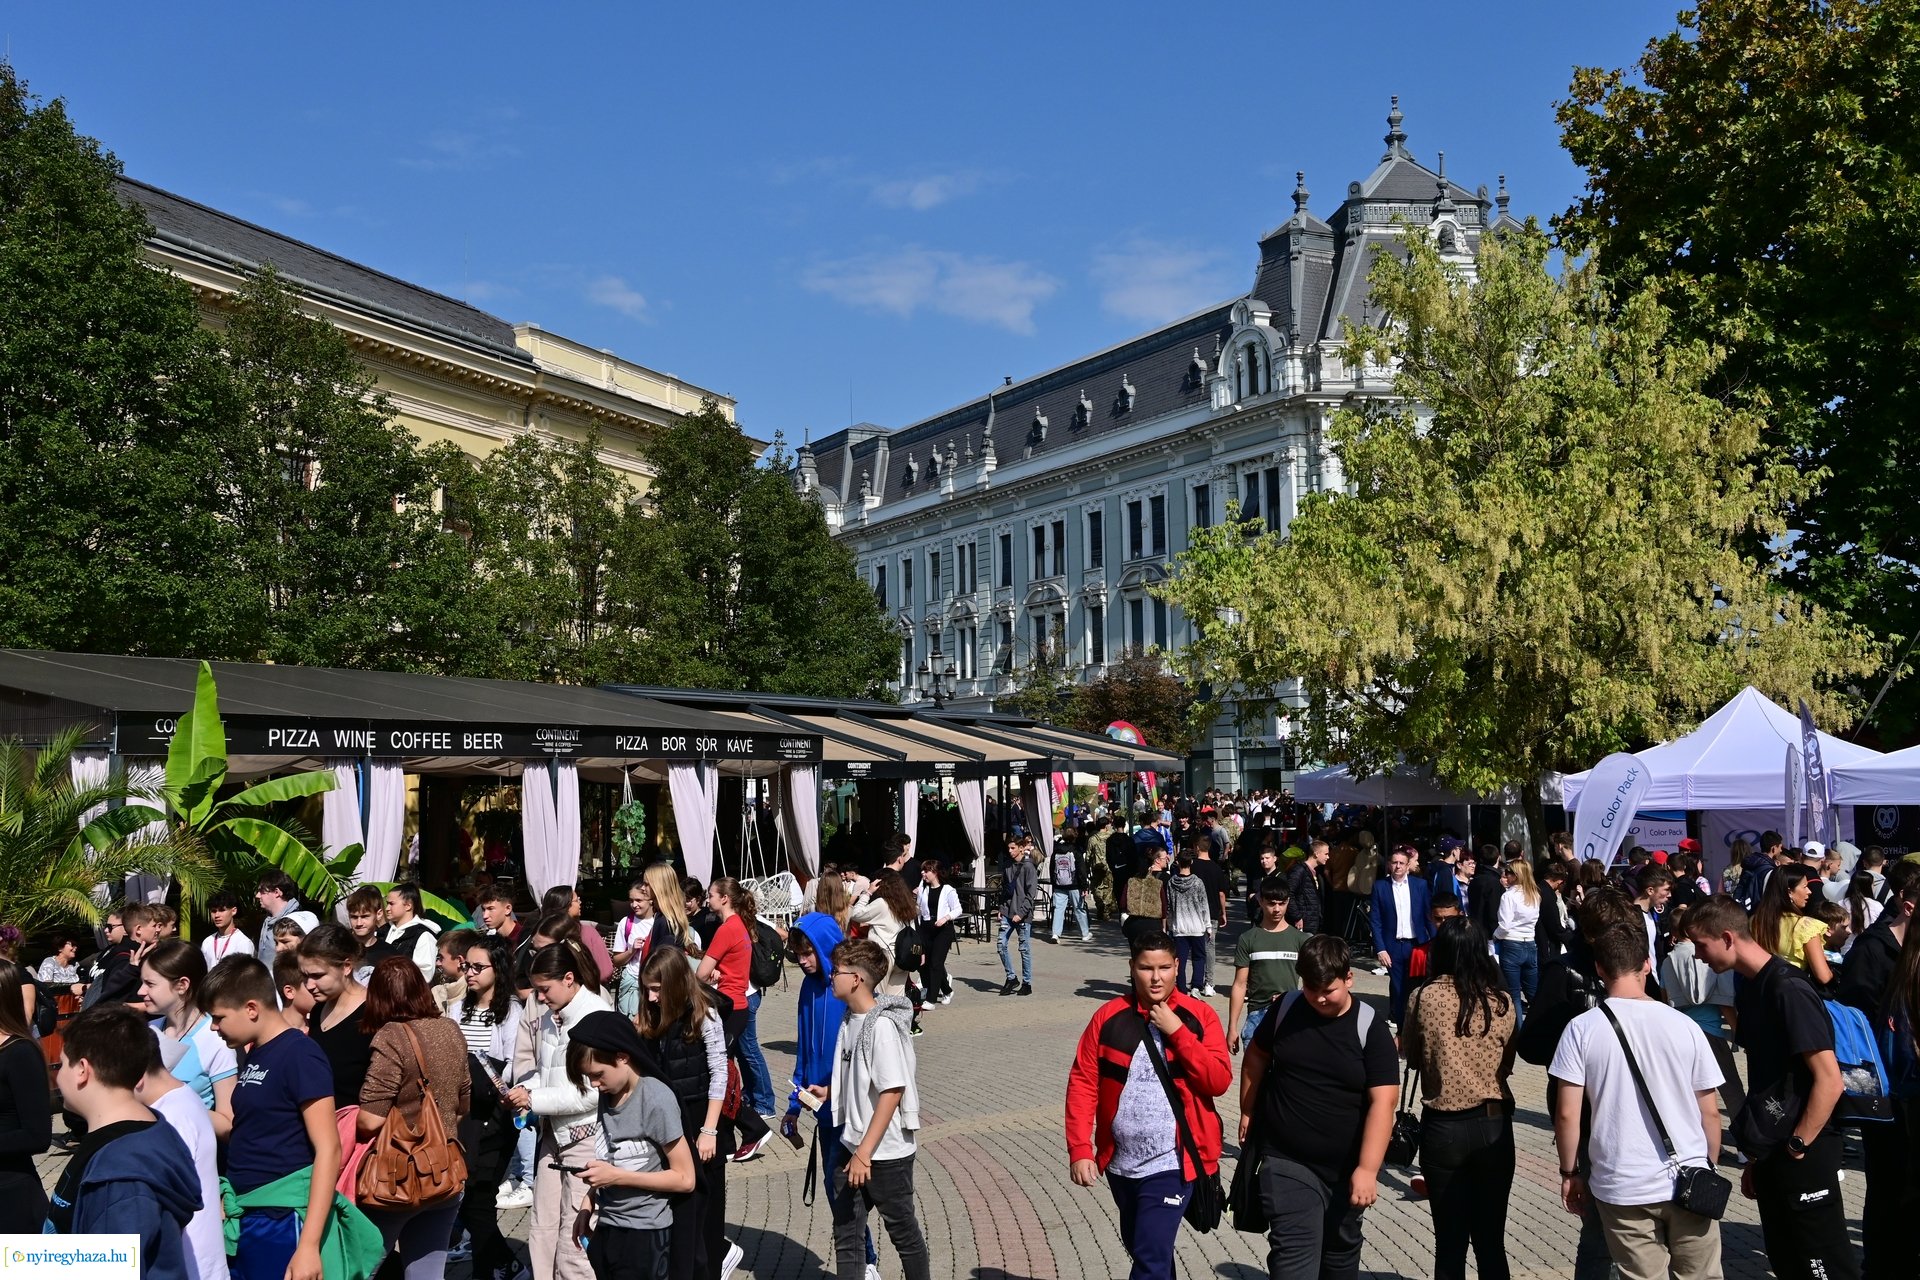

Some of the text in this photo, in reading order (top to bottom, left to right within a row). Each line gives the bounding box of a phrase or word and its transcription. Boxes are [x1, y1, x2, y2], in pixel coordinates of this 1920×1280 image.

[268, 729, 504, 750] PIZZA WINE COFFEE BEER
[536, 728, 581, 741] CONTINENT
[779, 738, 811, 749] CONTINENT
[615, 735, 649, 750] PIZZA
[661, 736, 687, 751] BOR
[726, 736, 754, 753] KÁVÉ
[1601, 767, 1640, 829] Color Pack
